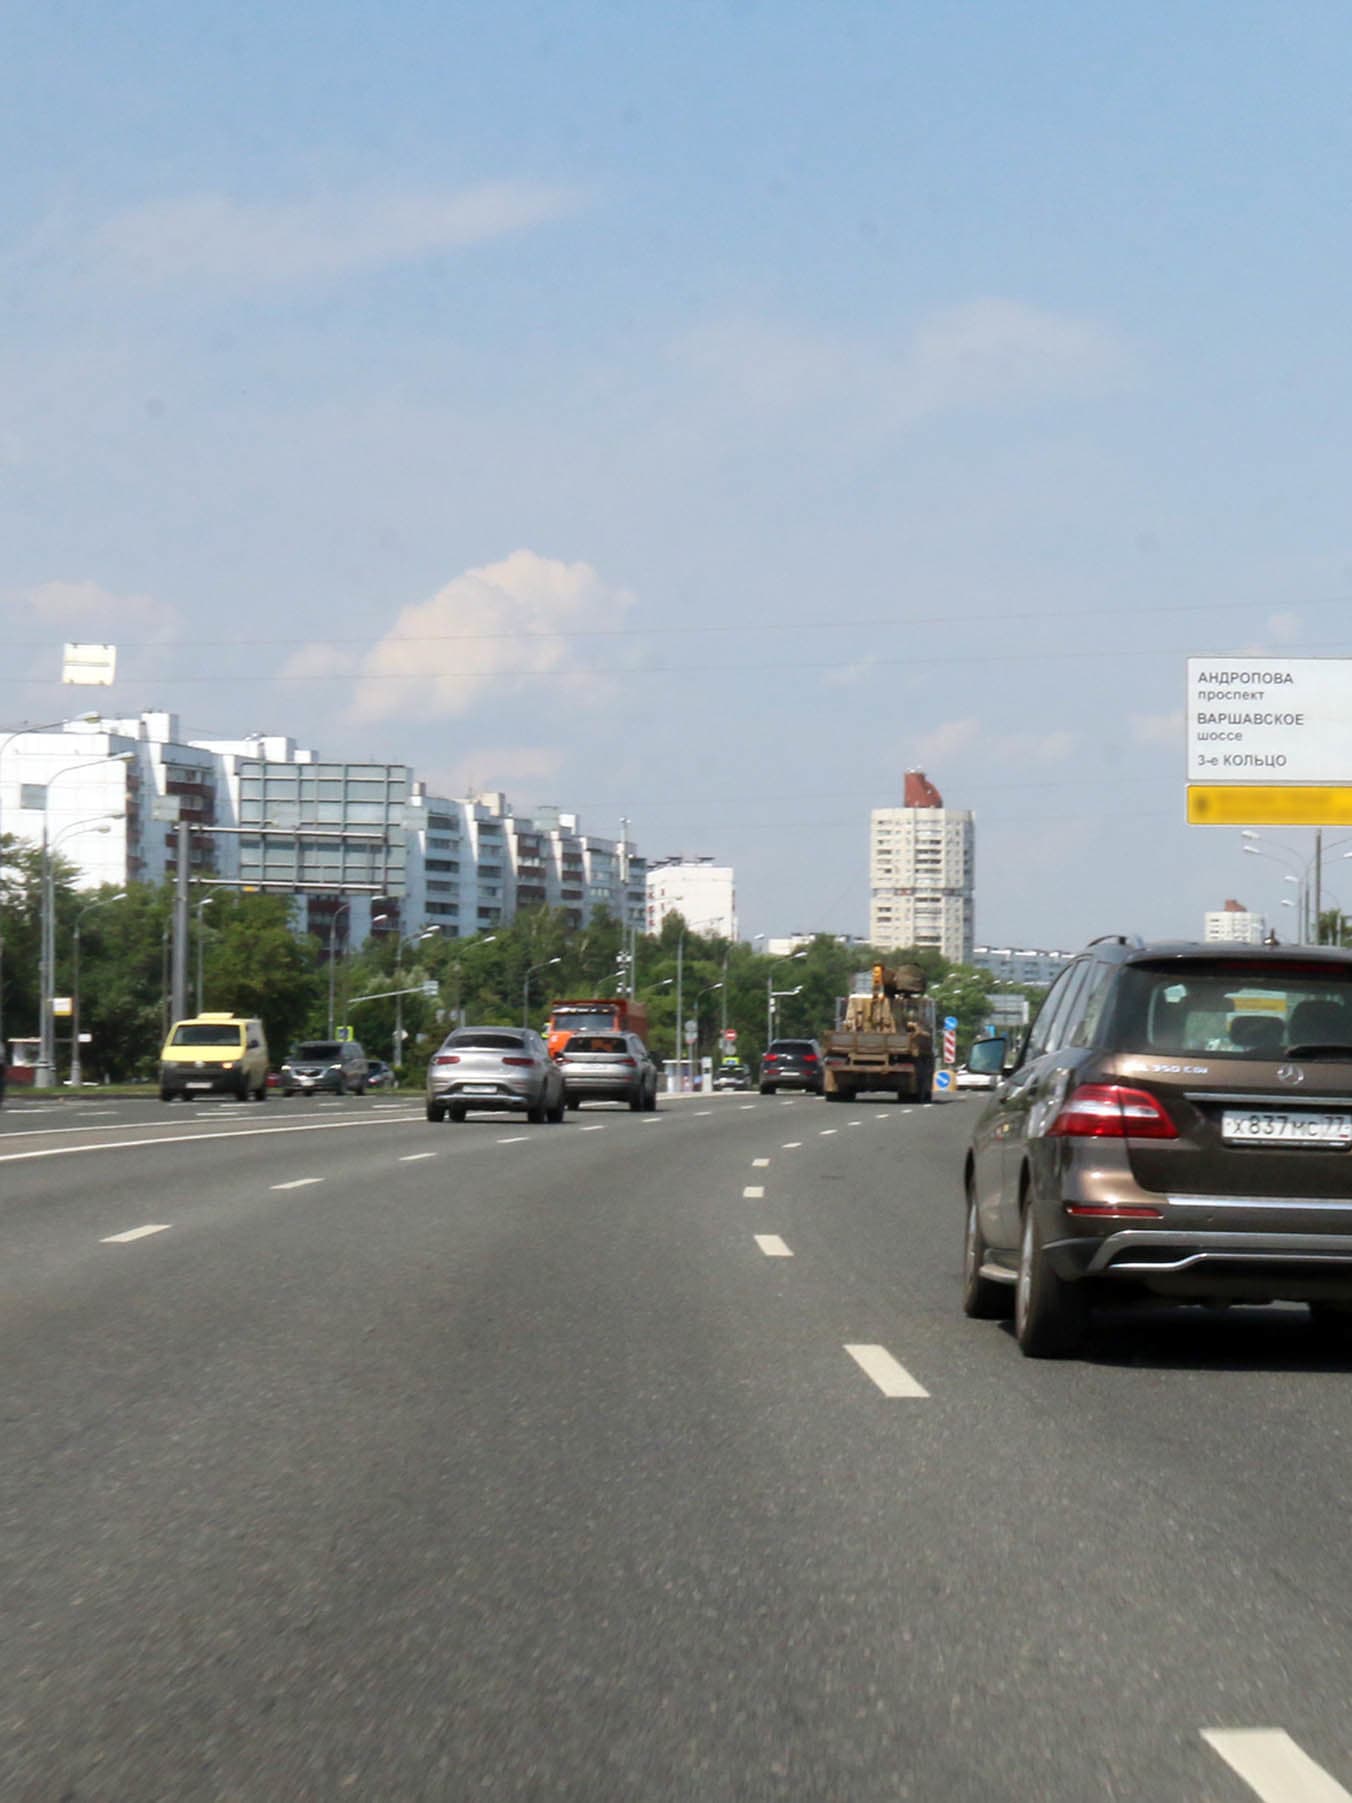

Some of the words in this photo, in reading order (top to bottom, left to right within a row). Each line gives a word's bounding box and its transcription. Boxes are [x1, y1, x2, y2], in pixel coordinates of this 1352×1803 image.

[1198, 671, 1294, 685] АНДРОПОВА
[1198, 690, 1264, 702] проспект
[1197, 712, 1305, 726] ВАРШАВСКОЕ
[1197, 732, 1243, 742] шоссе
[1198, 754, 1219, 766] 3-е
[1223, 754, 1288, 768] КОЛЬЦО
